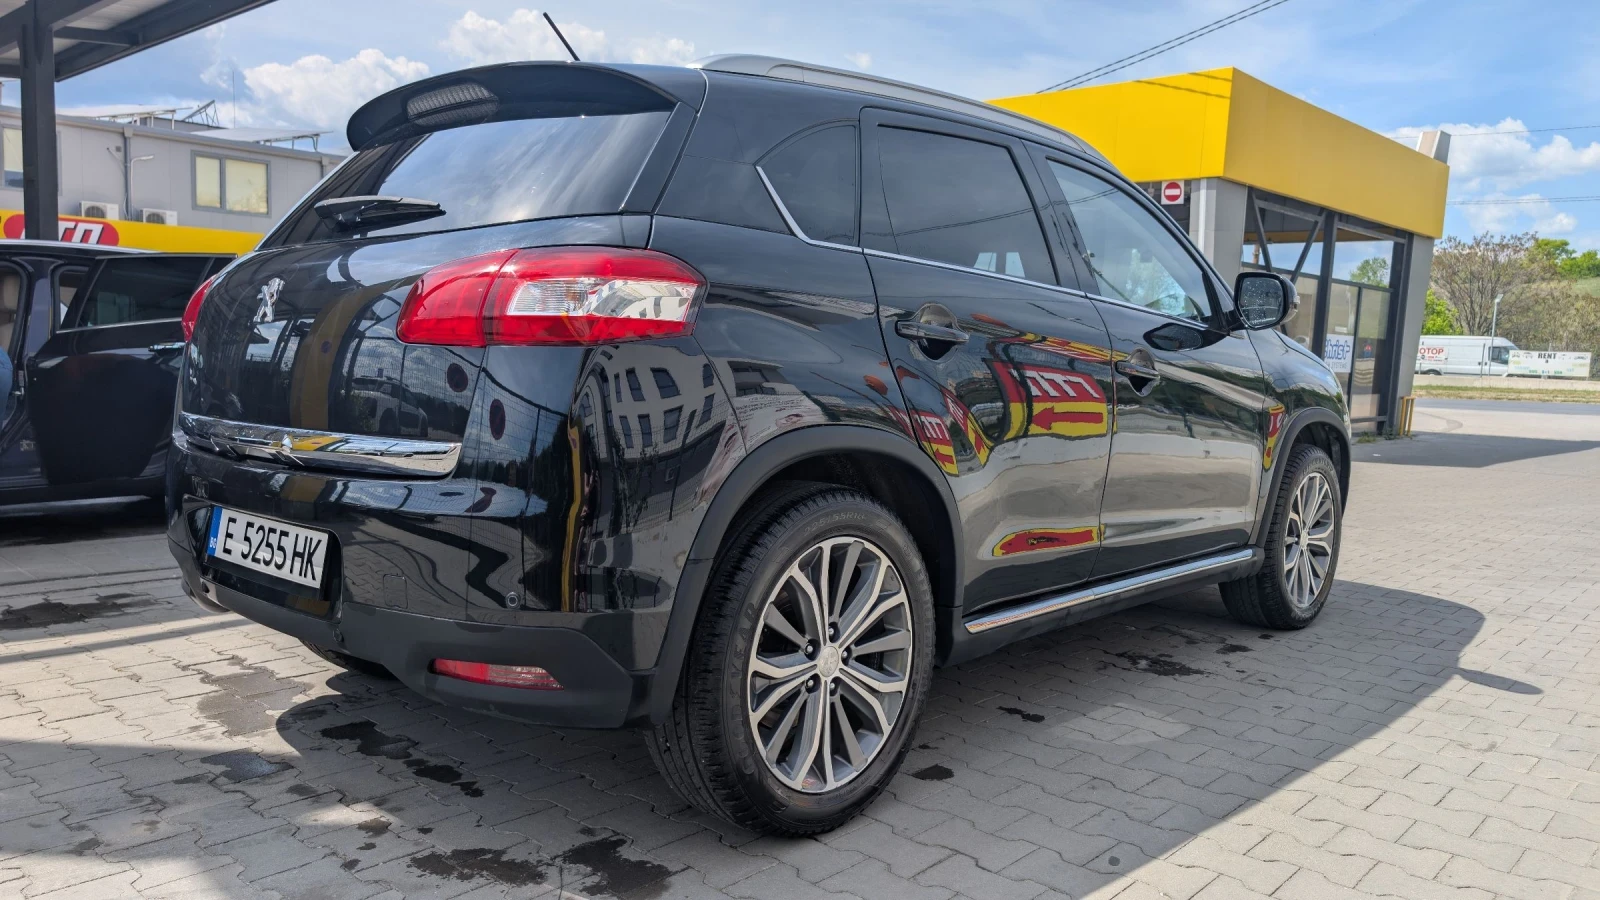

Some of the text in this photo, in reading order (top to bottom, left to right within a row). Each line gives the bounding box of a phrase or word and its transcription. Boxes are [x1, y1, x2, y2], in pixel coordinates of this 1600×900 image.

[1537, 352, 1557, 360] RENT
[222, 516, 323, 582] E 5255 HK
